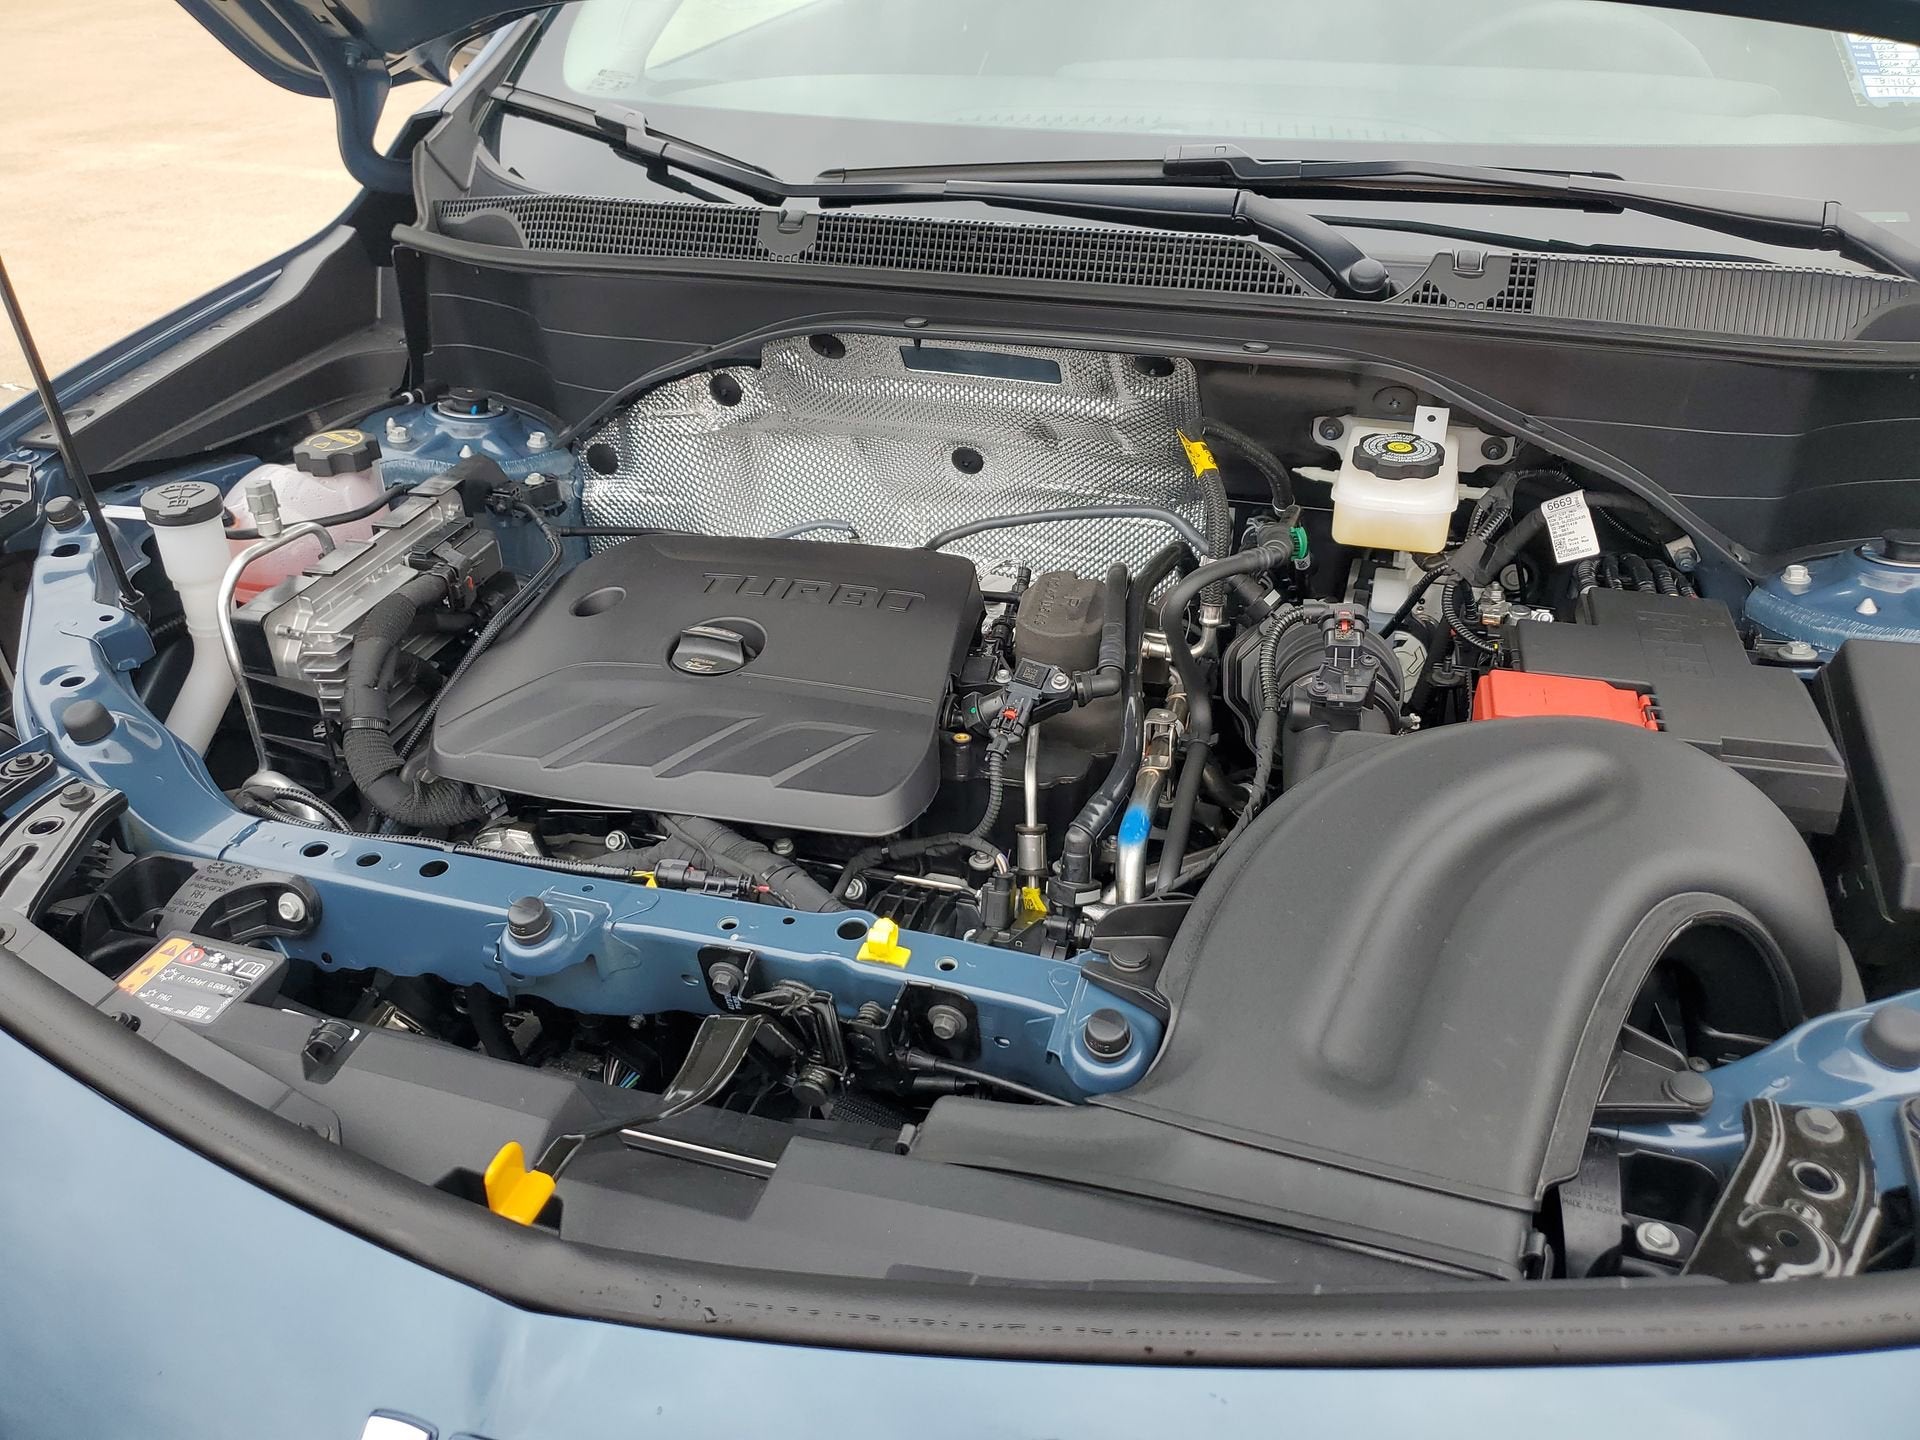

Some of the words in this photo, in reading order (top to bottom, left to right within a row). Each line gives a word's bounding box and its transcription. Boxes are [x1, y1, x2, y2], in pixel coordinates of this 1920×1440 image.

[1547, 496, 1572, 510] 6669
[702, 572, 926, 612] TURBO
[190, 889, 206, 899] RH
[201, 961, 217, 969] AUTO
[156, 992, 172, 1001] PAG
